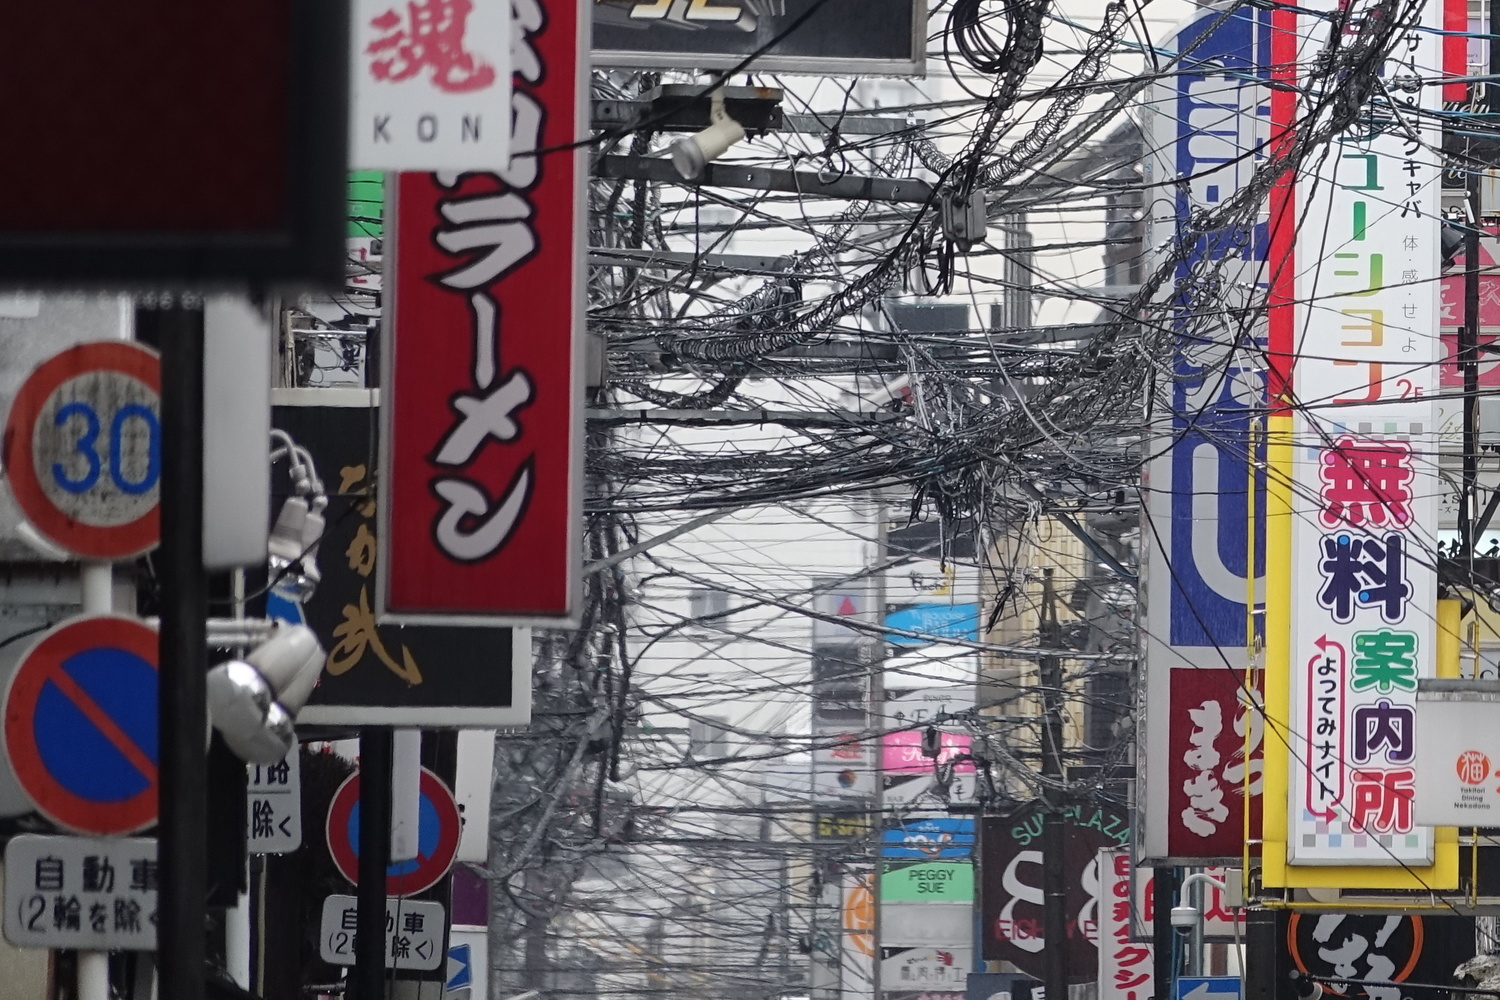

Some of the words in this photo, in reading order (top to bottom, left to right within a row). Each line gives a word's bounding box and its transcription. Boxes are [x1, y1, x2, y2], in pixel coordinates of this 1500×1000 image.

[373, 114, 483, 144] KON
[53, 403, 160, 495] 30
[1317, 436, 1418, 835] 無料案内所
[1316, 657, 1338, 801] よってみナイト
[247, 800, 292, 839] 除く
[35, 855, 158, 894] 自動車
[909, 870, 955, 881] PEGGY
[917, 883, 945, 893] SUE
[328, 932, 434, 961] (2除く)
